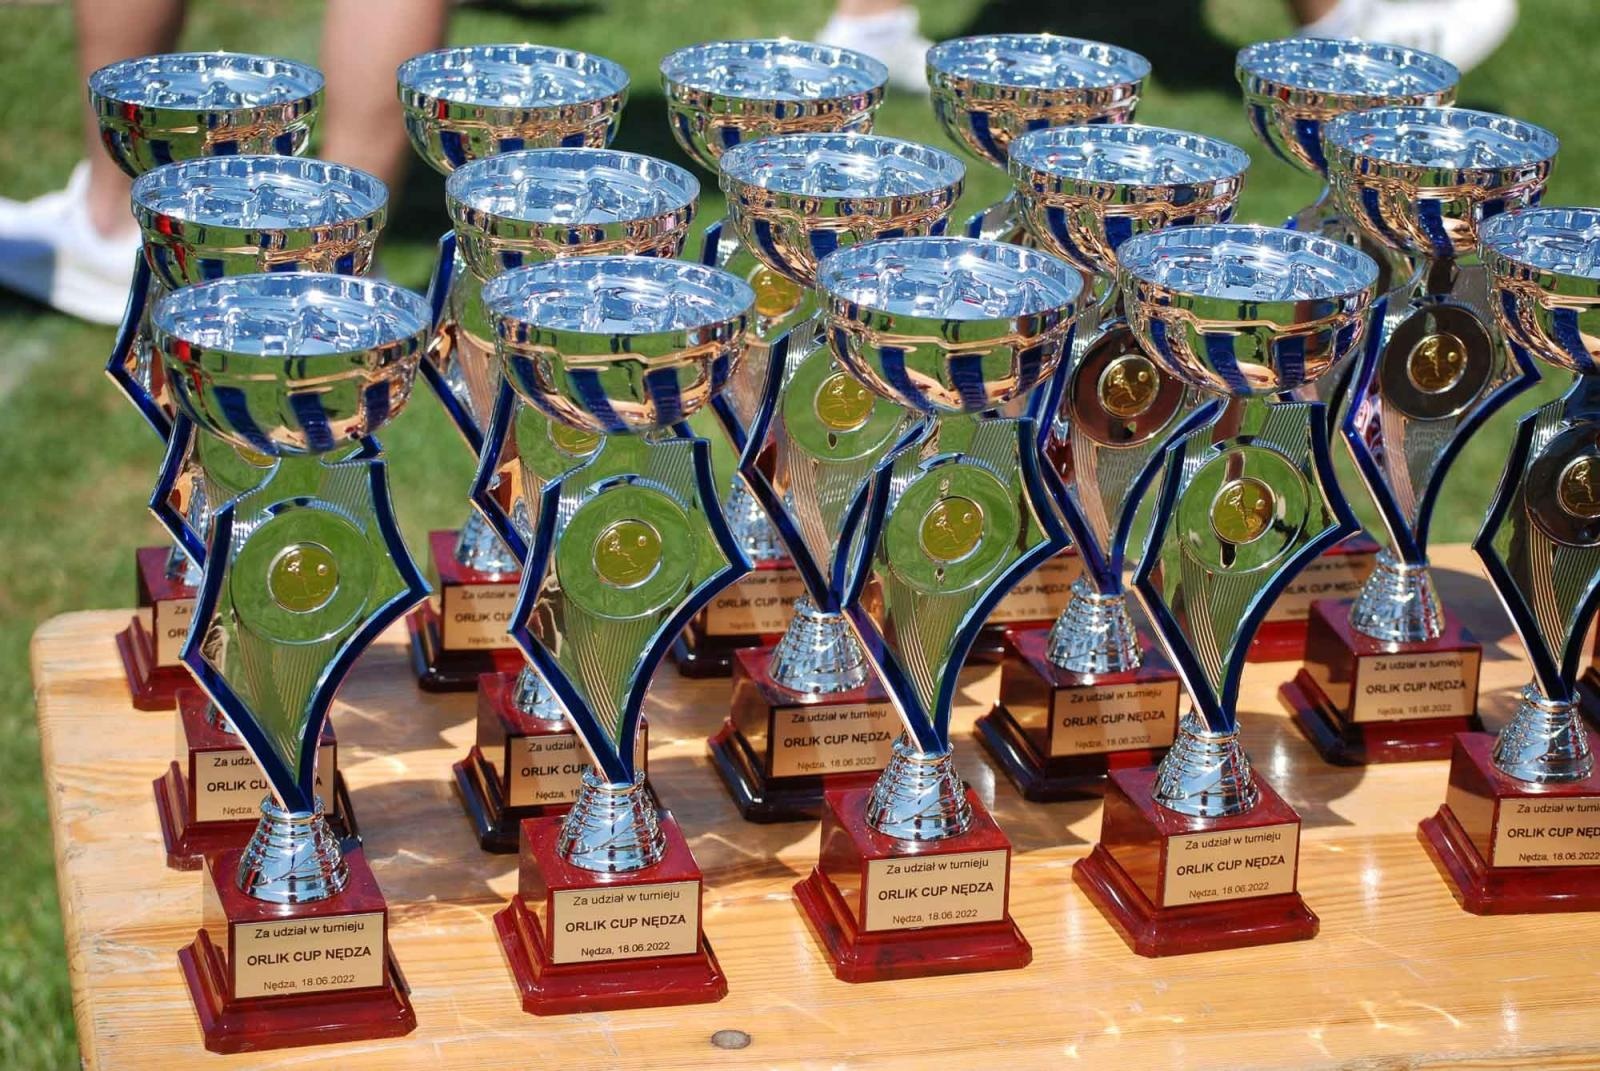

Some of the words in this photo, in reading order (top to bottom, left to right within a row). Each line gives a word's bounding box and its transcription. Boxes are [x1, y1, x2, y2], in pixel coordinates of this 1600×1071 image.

[455, 613, 489, 622] ORLIK
[494, 612, 512, 621] CU
[1366, 684, 1400, 694] ORLIK
[1403, 683, 1427, 692] CUP
[1429, 680, 1466, 692] NĘDZA
[1070, 694, 1083, 704] Za
[792, 714, 805, 723] Za
[808, 712, 837, 721] udział
[839, 712, 848, 720] w
[850, 709, 886, 720] turnieju
[1063, 716, 1098, 728] ORLIK
[1101, 713, 1125, 724] CUP
[1128, 710, 1166, 723] NĘDZA
[528, 743, 542, 752] Za
[546, 741, 576, 751] udział
[784, 736, 820, 748] ORLIK
[824, 734, 849, 745] CUP
[852, 731, 891, 743] NĘDZA
[214, 758, 228, 767] Za
[231, 756, 256, 766] udzi
[522, 766, 559, 777] ORLIK
[207, 782, 246, 792] ORLIK
[250, 780, 271, 790] CU
[1517, 804, 1530, 813] Za
[1534, 803, 1563, 813] udział
[1507, 828, 1545, 838] ORLIK
[1548, 828, 1574, 837] CUP
[1185, 840, 1198, 850] Za
[1202, 837, 1230, 848] udział
[1245, 832, 1281, 844] turnieju
[886, 865, 900, 874] Za
[904, 862, 935, 873] udział
[950, 858, 989, 870] turnieju
[1176, 863, 1214, 876] ORLIK
[1217, 860, 1242, 871] CUP
[1245, 855, 1285, 870] NĘDZA
[878, 888, 918, 900] ORLIK
[921, 886, 948, 897] CUP
[952, 882, 994, 896] NĘDZA
[1222, 882, 1269, 895] 18.06.2022
[573, 896, 588, 906] Za
[591, 893, 624, 905] udział
[626, 894, 636, 902] w
[640, 890, 680, 902] turnieju
[928, 909, 978, 921] 18.06.2022
[255, 929, 270, 939] Za
[274, 925, 307, 936] udział
[310, 926, 320, 934] w
[324, 921, 364, 933] turnieju
[565, 920, 606, 932] ORLIK
[610, 918, 638, 929] CUP
[642, 914, 686, 928] NĘDZA
[247, 953, 290, 966] ORLIK
[293, 950, 321, 962] CUP
[326, 946, 372, 960] NĘDZA
[581, 947, 614, 957] Nędza,
[618, 941, 670, 953] 18.06.2022
[302, 974, 355, 986] 18.06.2022
